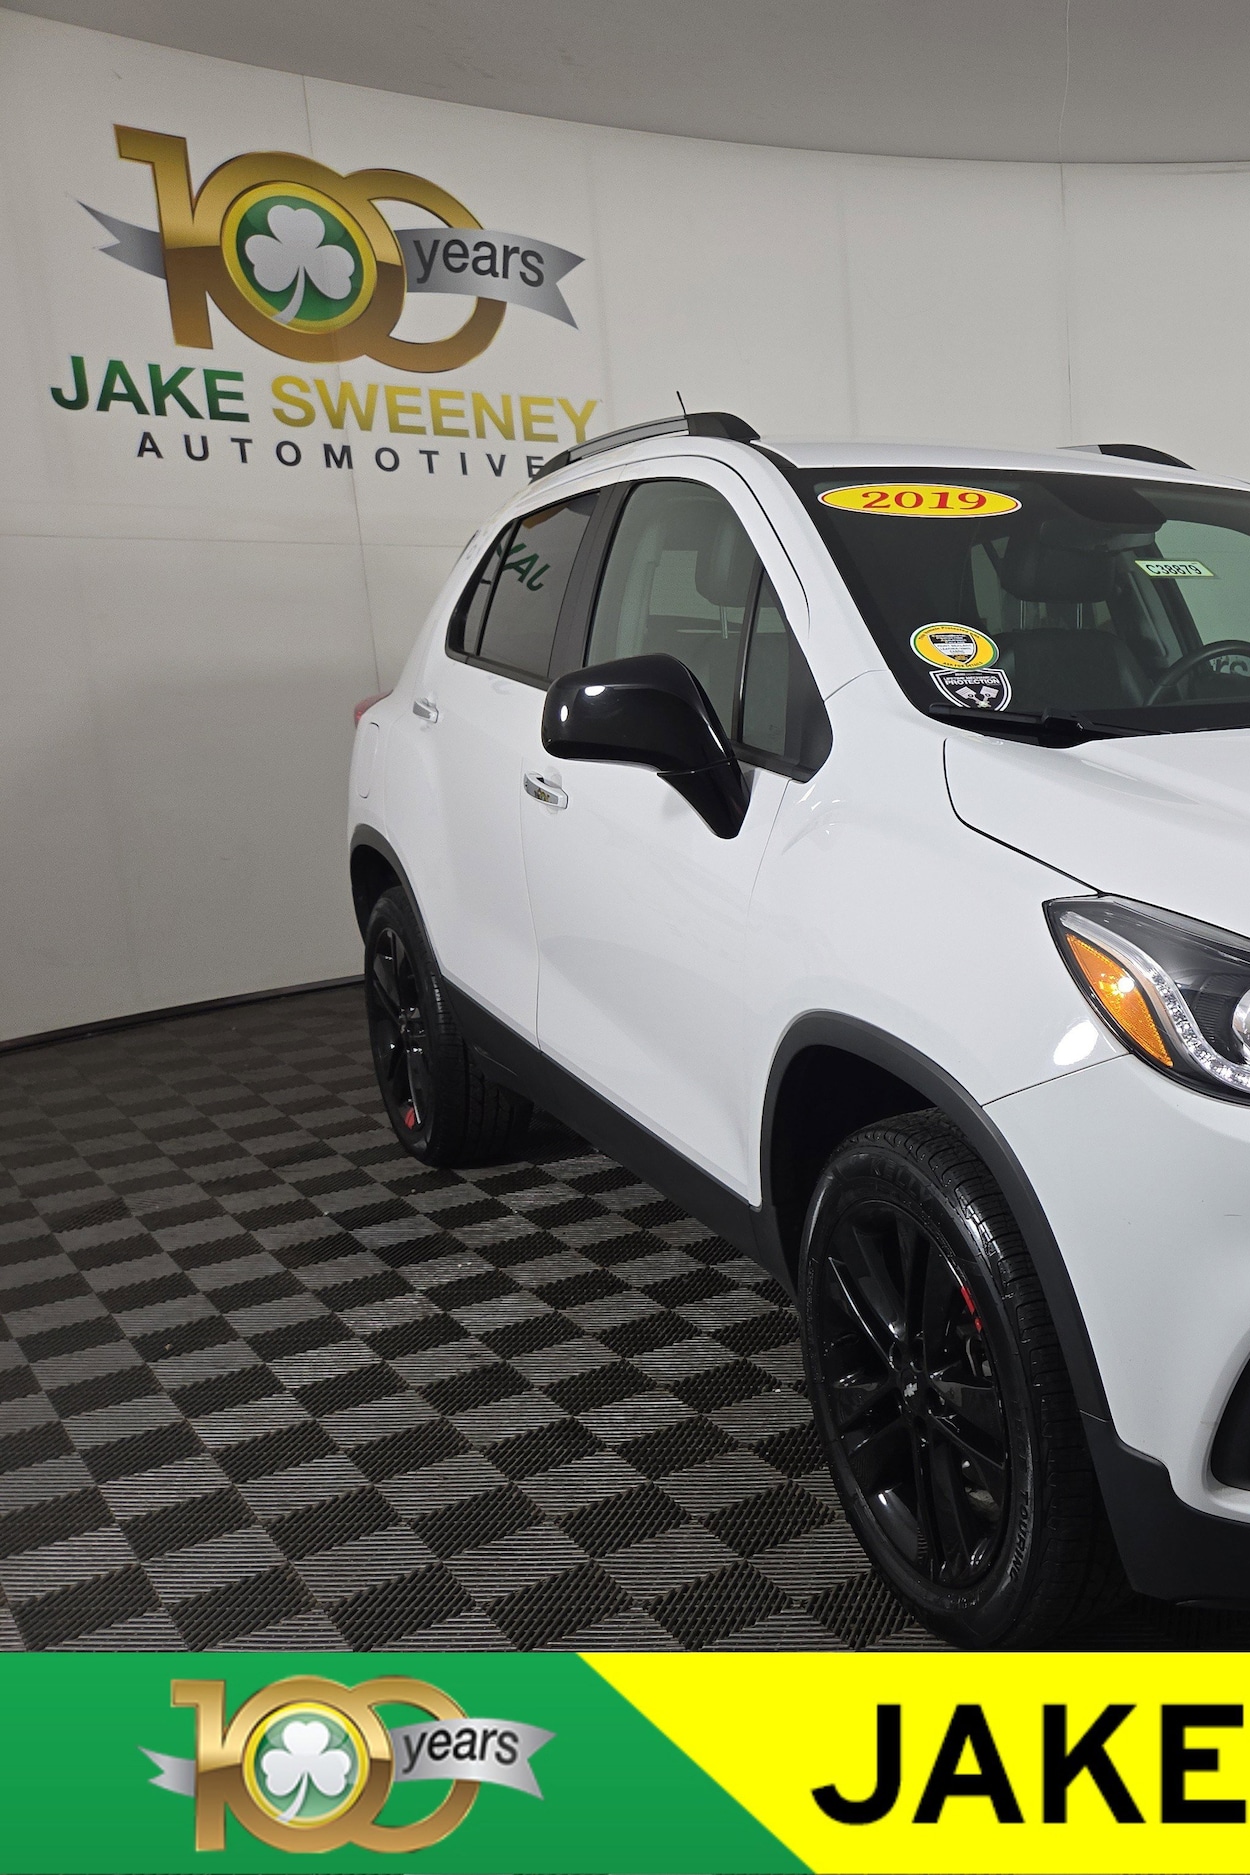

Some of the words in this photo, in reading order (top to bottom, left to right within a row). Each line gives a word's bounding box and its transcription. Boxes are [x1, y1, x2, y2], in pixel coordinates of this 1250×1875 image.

[413, 236, 546, 288] years
[50, 355, 250, 423] JAKE
[270, 375, 597, 444] SWEENEY
[136, 431, 545, 478] AUTOMOTIVE
[861, 490, 987, 511] 2019
[1145, 564, 1202, 575] C38879
[944, 678, 1001, 686] PROTECTION
